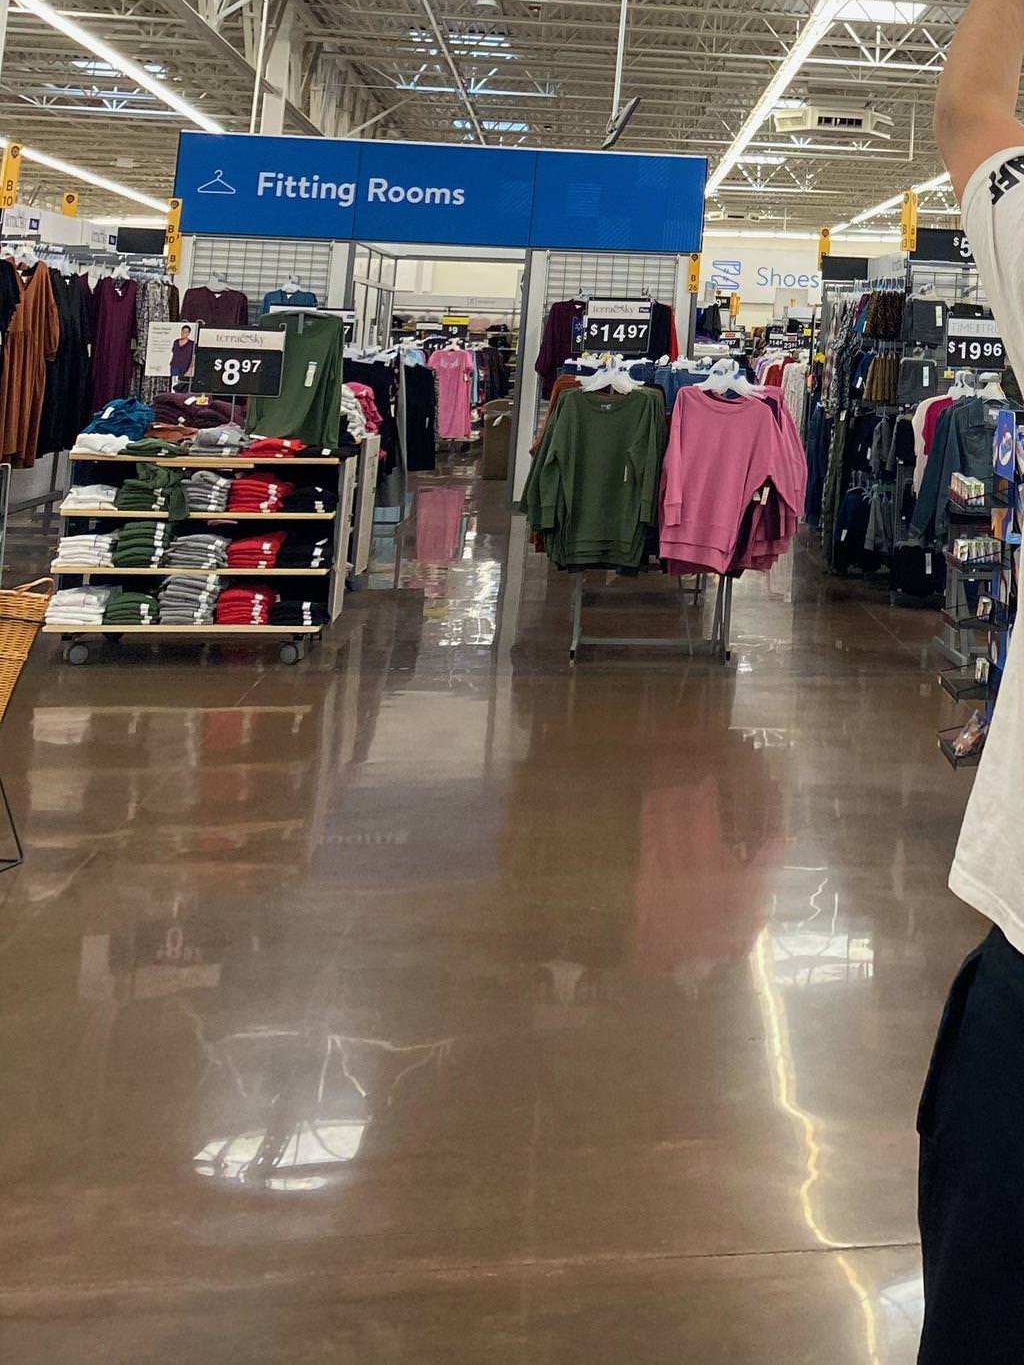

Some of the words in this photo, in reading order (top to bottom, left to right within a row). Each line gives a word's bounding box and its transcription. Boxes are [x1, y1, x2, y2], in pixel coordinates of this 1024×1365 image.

[256, 171, 356, 207] Fitting
[367, 177, 465, 205] Rooms
[756, 266, 819, 289] Shoes
